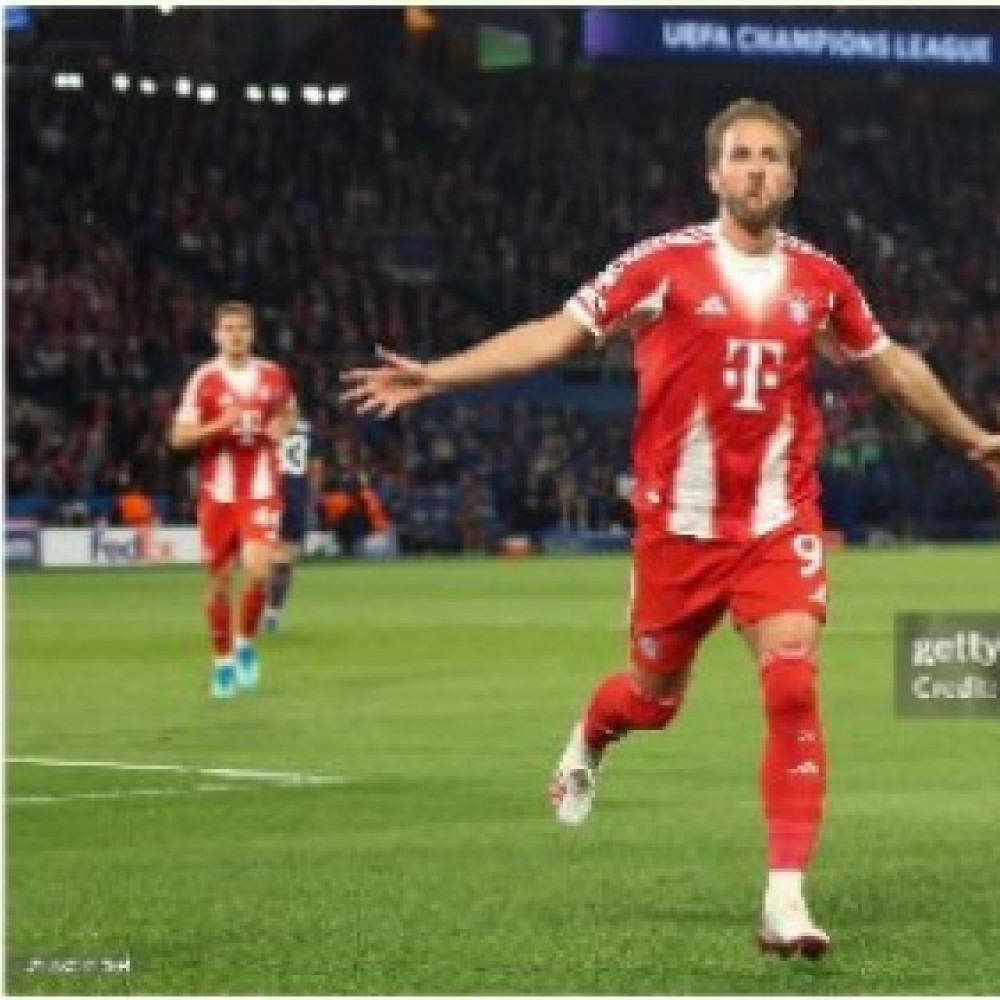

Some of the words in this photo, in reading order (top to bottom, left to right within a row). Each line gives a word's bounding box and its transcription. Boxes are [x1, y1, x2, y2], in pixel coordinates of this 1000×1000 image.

[661, 21, 731, 50] UEFA
[736, 24, 889, 58] CHAMPIONS
[893, 32, 992, 64] LEAGUE
[723, 337, 787, 413] T
[793, 534, 823, 578] 9
